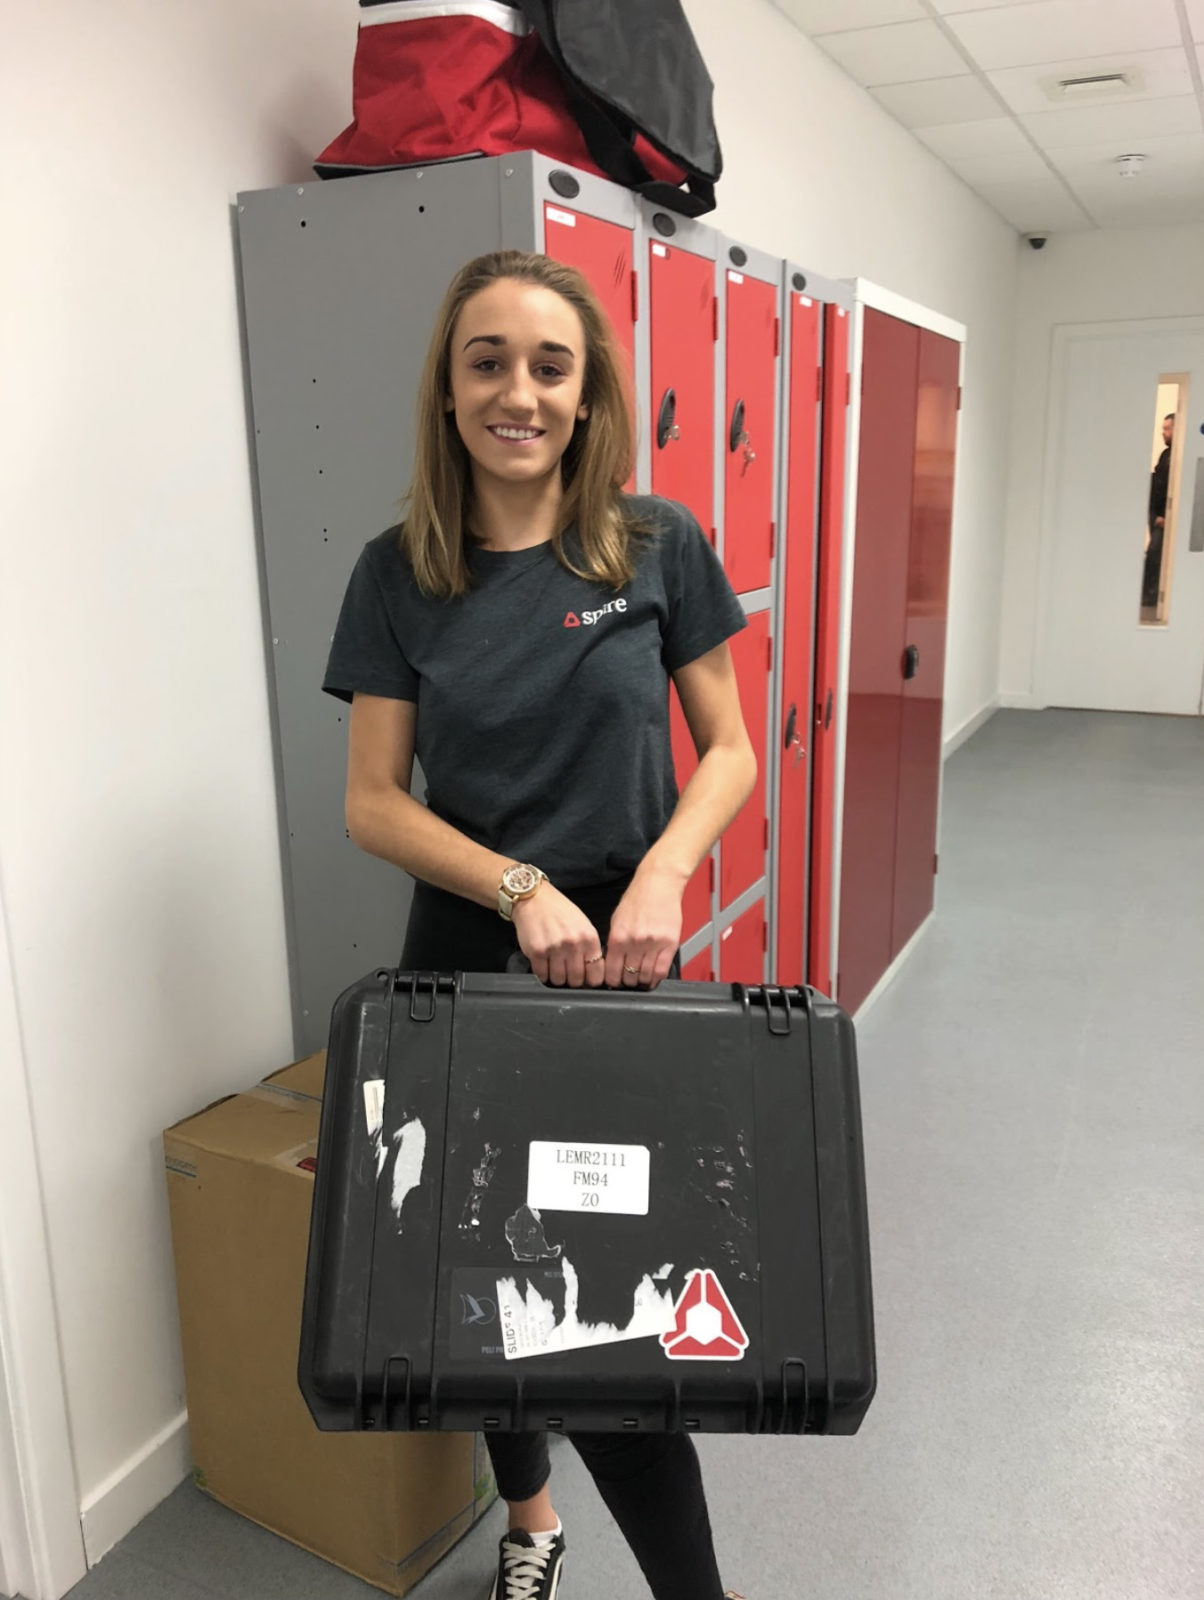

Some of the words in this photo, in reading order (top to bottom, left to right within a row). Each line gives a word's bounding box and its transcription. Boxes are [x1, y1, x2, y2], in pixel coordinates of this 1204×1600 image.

[581, 598, 627, 625] spire
[556, 1149, 626, 1167] LEMR2111
[573, 1171, 608, 1187] FM94
